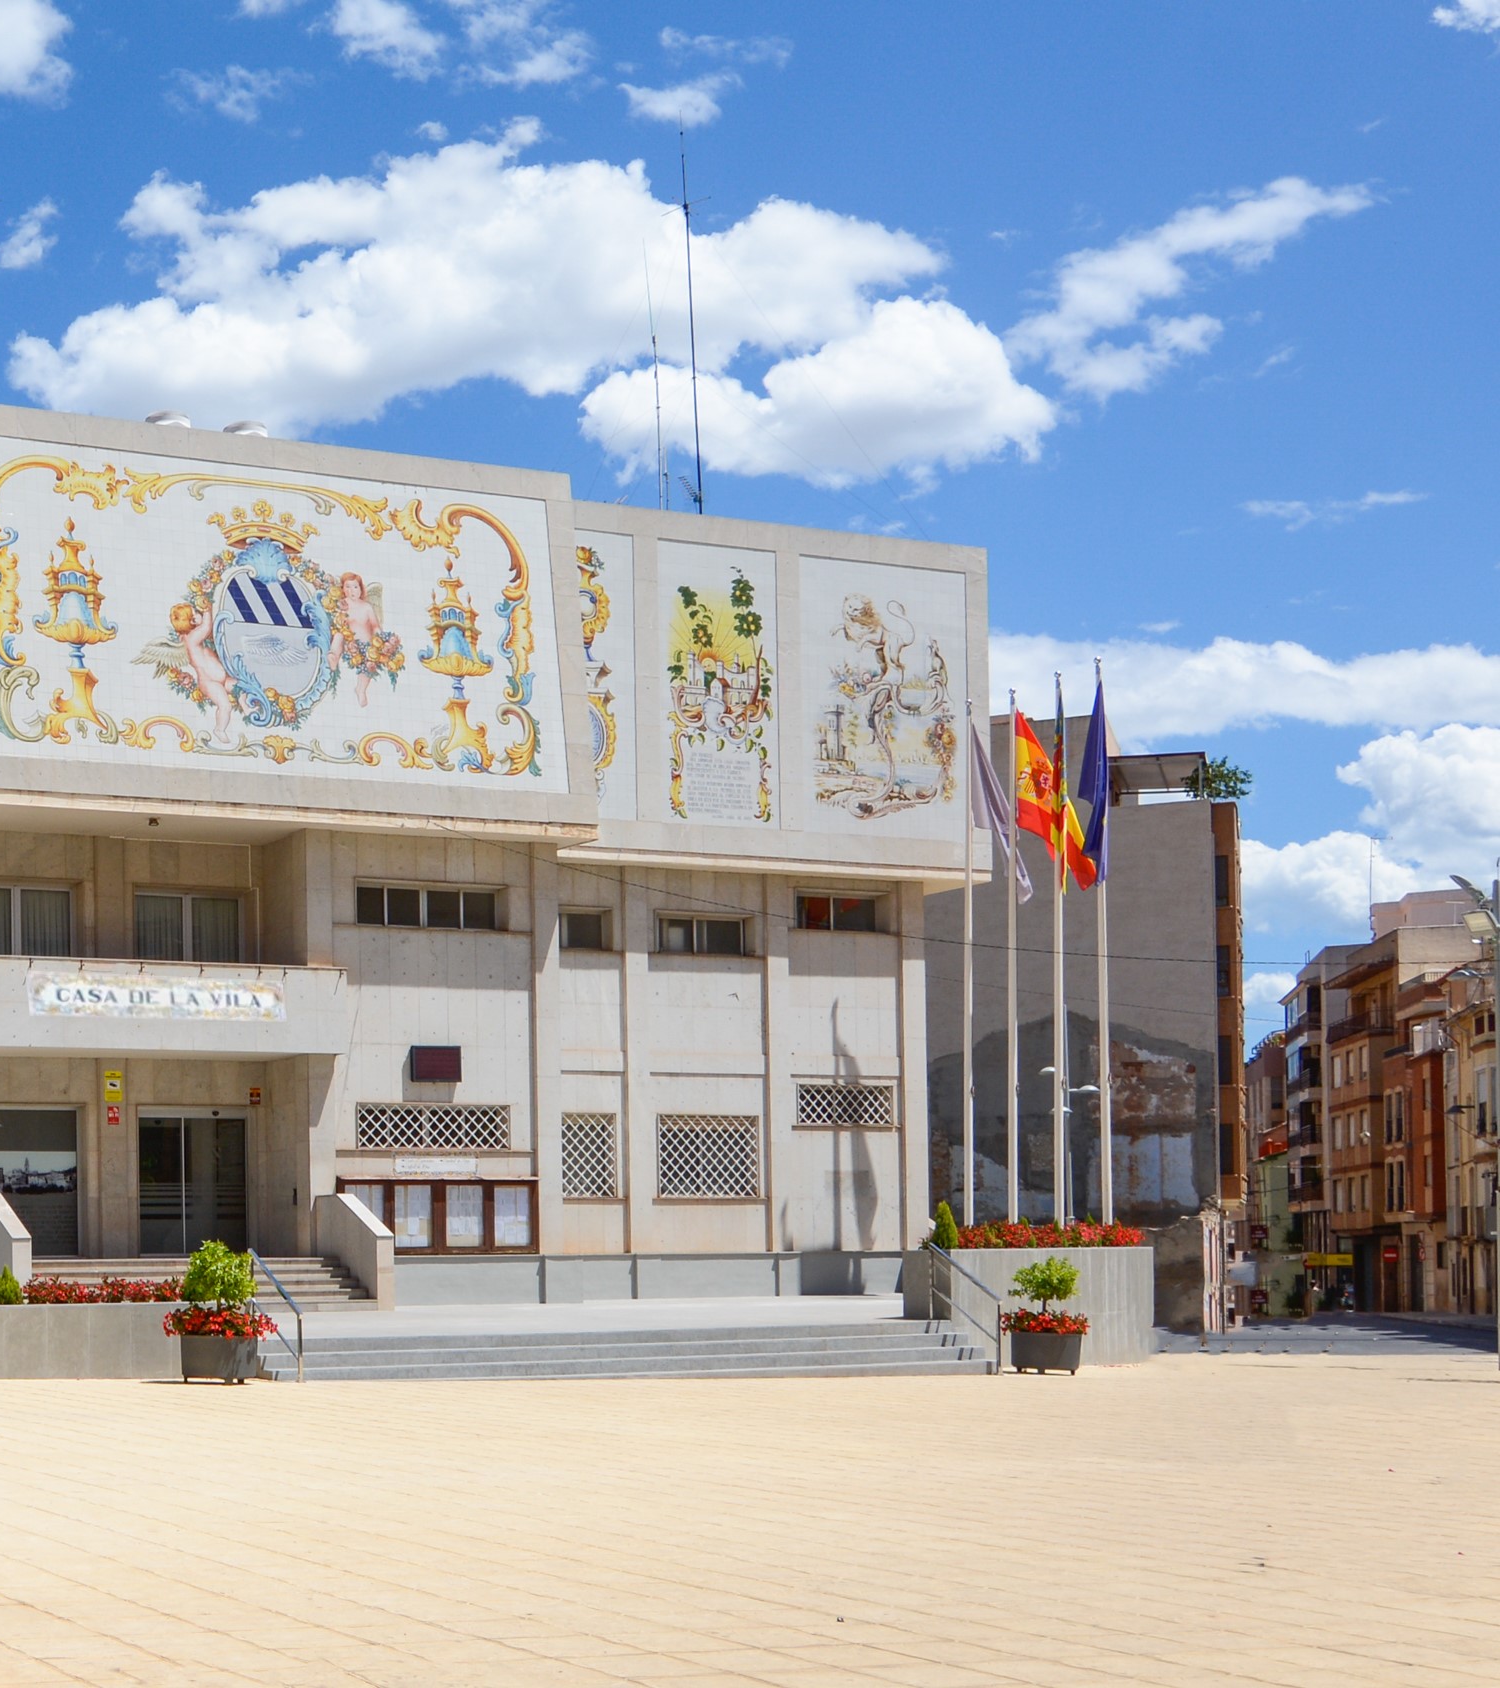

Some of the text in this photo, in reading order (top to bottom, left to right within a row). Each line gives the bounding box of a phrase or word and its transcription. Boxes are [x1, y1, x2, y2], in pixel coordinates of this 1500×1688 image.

[55, 987, 261, 1008] CASA DE LA VILA
